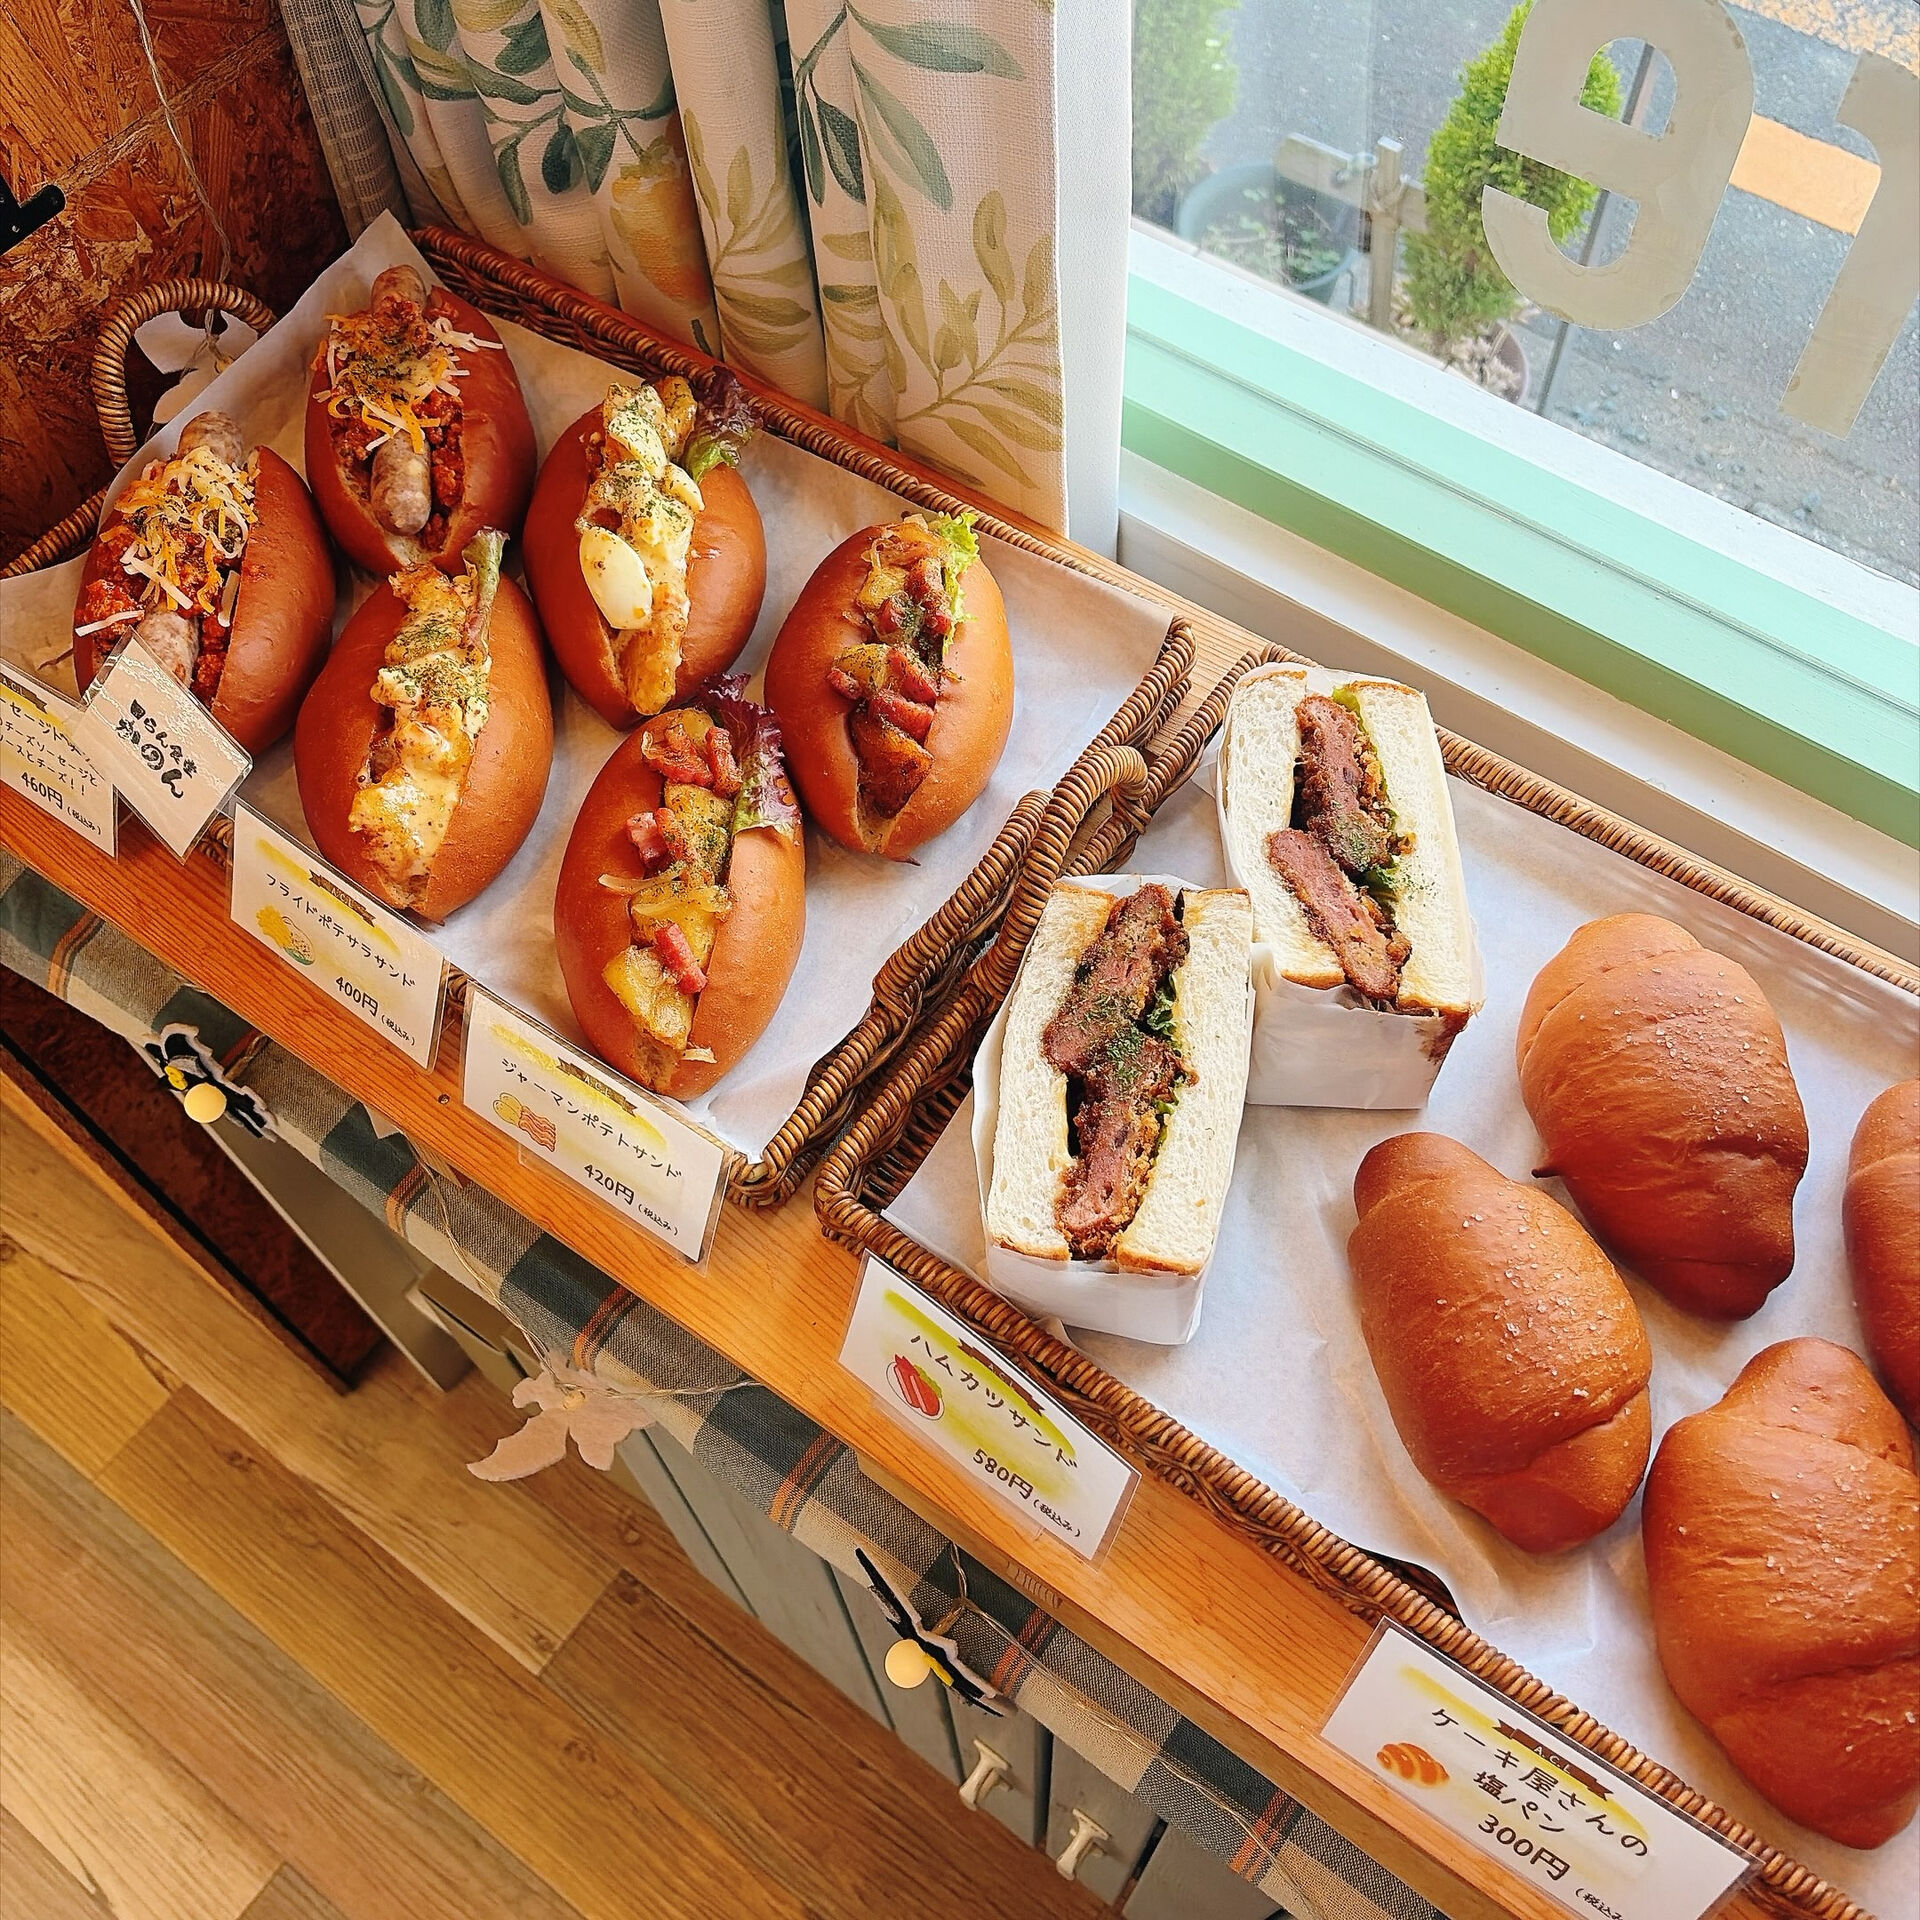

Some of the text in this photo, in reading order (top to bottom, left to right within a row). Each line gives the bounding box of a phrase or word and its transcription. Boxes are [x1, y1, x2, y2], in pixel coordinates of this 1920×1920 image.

[21, 771, 64, 811] 460円
[266, 872, 415, 988] フライドポテサラサンド
[335, 976, 379, 1017] 400円
[501, 1058, 682, 1178] ジャーマンポテトサンド
[583, 1163, 635, 1206] 420円
[910, 1335, 1078, 1469] ハムカツサンド
[972, 1448, 1034, 1500] 580円
[1431, 1708, 1648, 1857] ケーキ屋さんの
[1473, 1770, 1567, 1834] 塩パン
[1477, 1813, 1571, 1881] 300円
